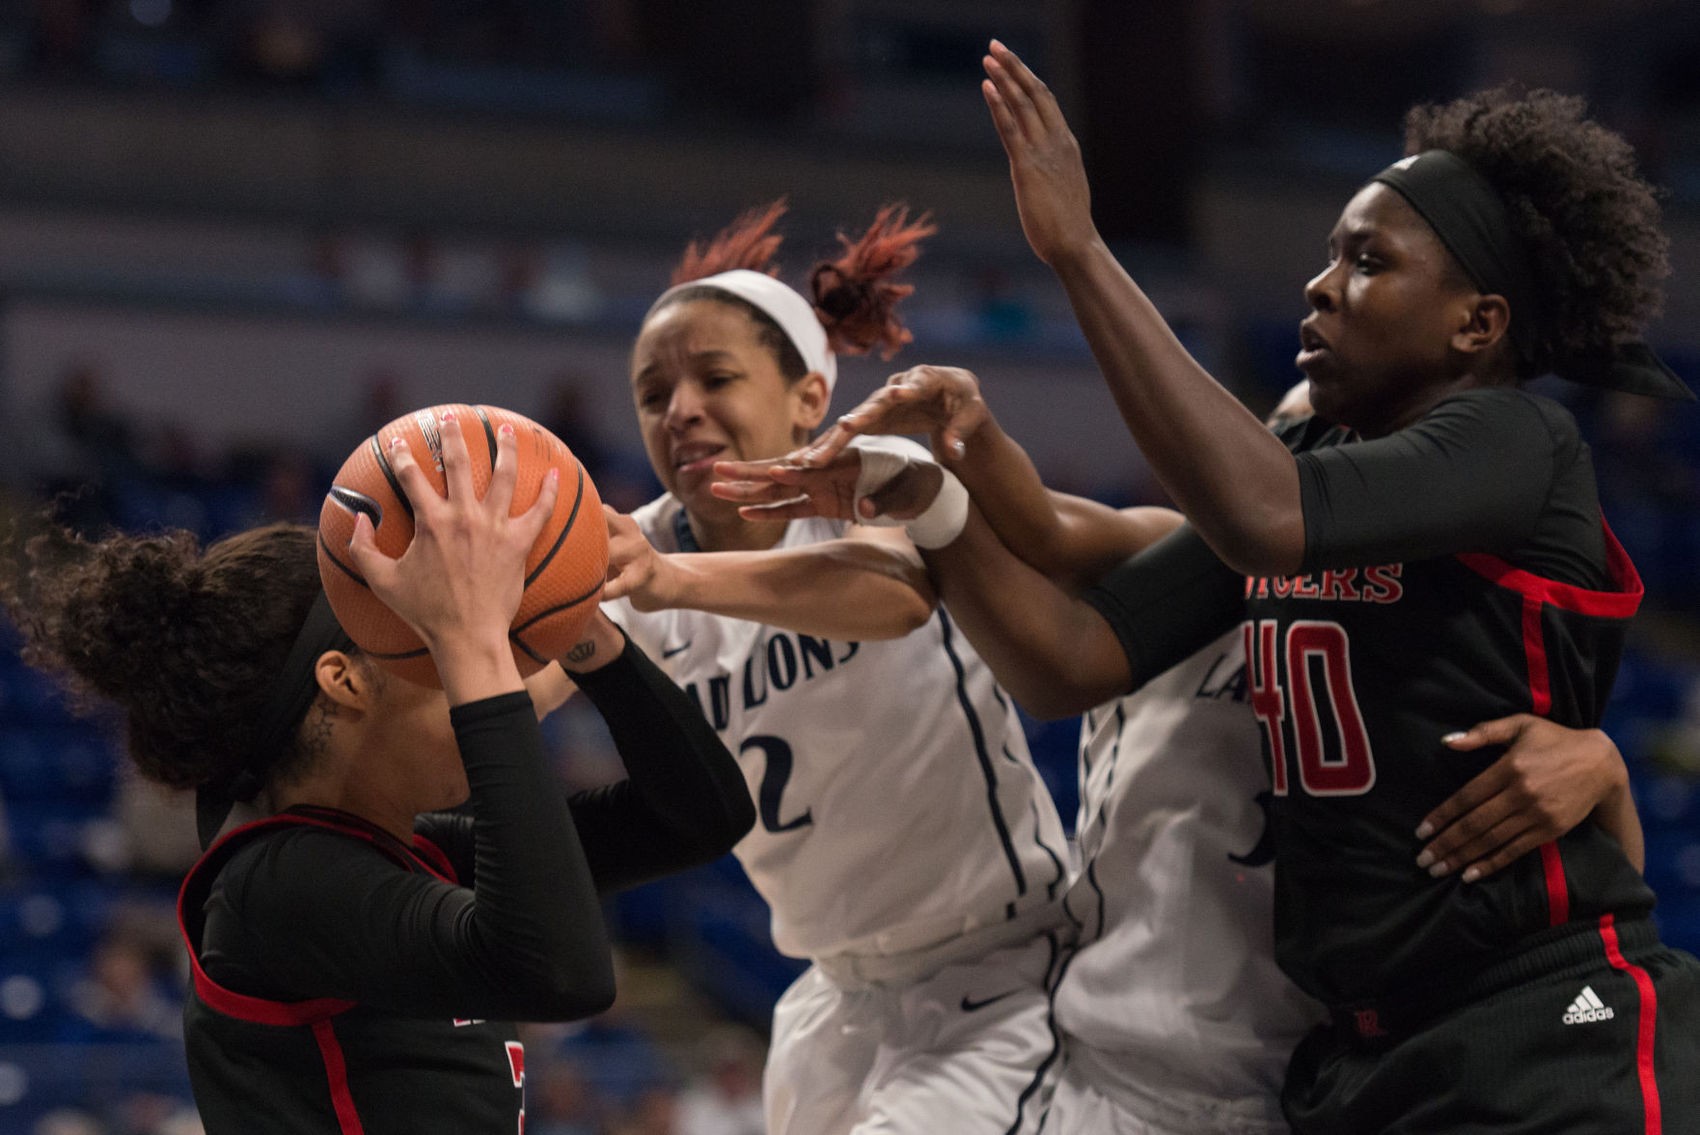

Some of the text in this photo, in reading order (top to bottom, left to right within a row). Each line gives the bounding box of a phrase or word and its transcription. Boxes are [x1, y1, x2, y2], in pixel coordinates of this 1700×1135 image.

[1244, 619, 1376, 796] 40
[740, 735, 814, 834] 2
[1562, 1006, 1615, 1025] adidas
